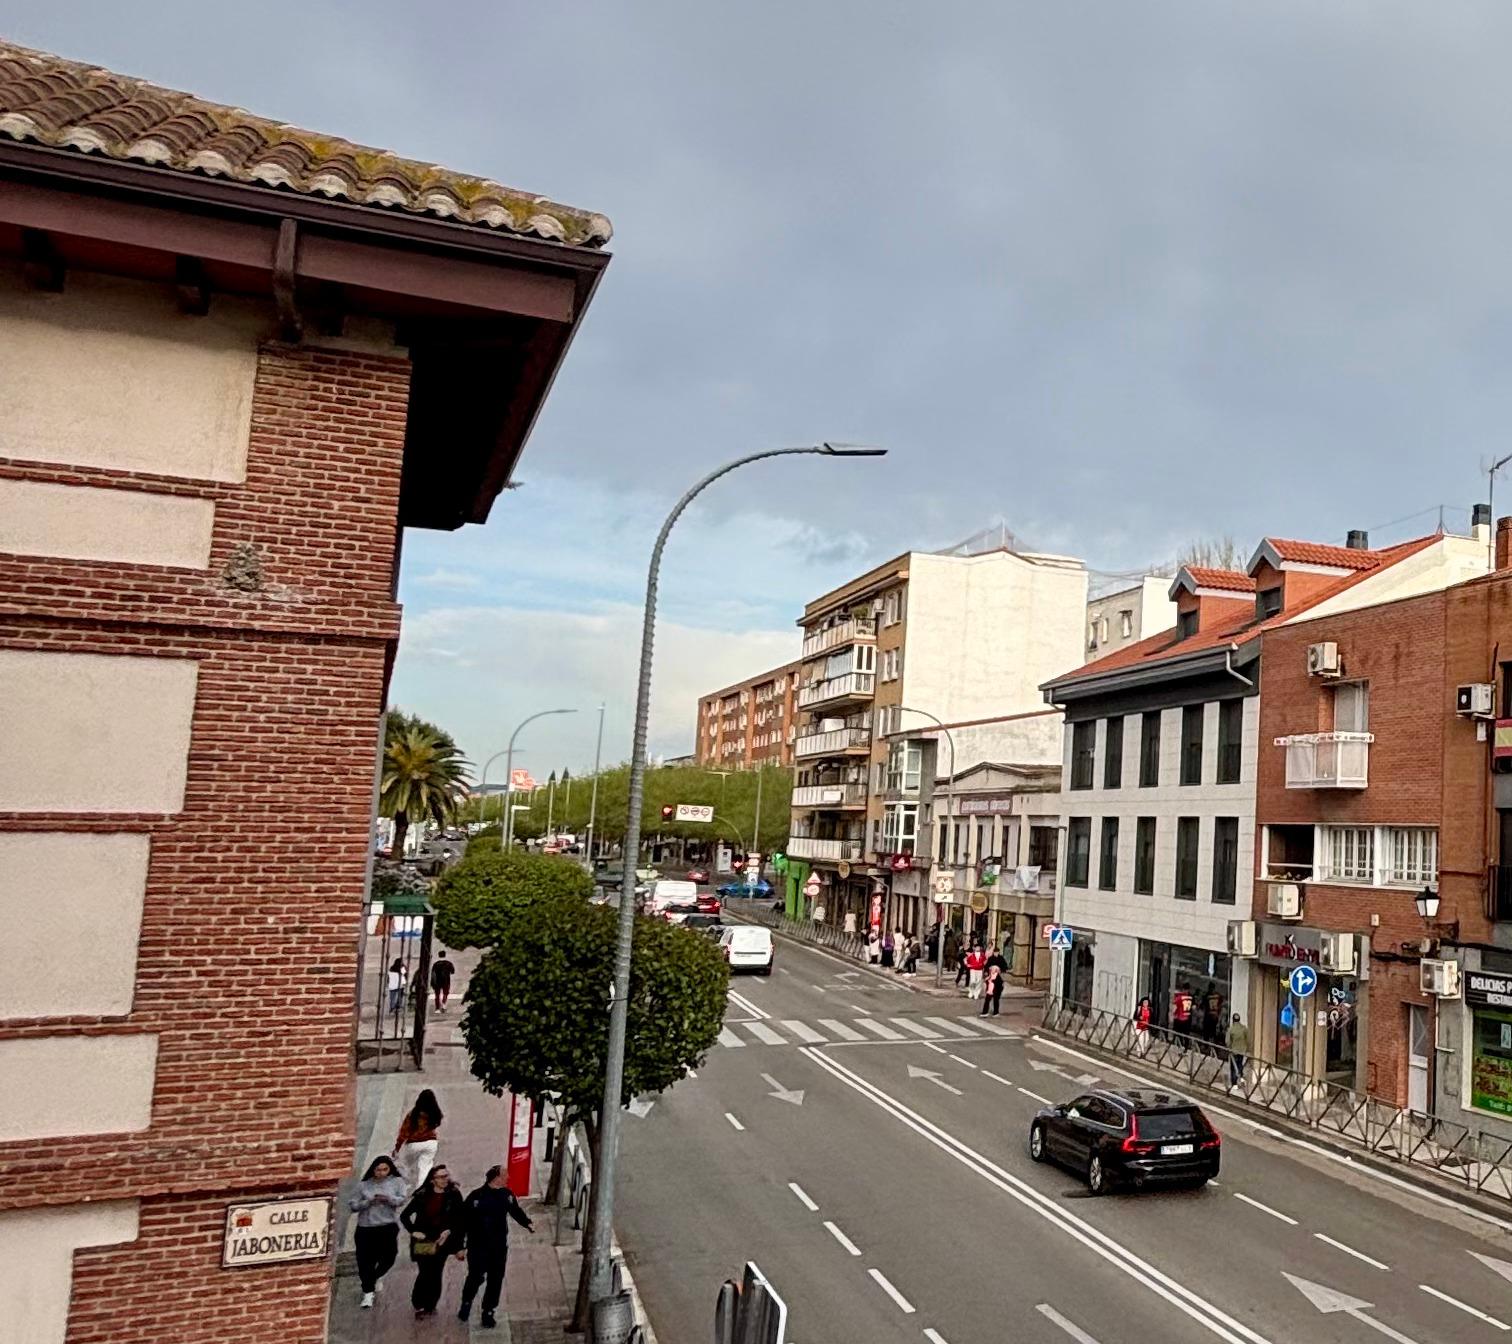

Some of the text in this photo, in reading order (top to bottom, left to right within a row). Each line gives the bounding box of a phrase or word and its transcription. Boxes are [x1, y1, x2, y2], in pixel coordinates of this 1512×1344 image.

[1470, 976, 1506, 992] DELICIAS
[269, 1210, 309, 1225] CALLE
[232, 1232, 319, 1258] JABONERIA
